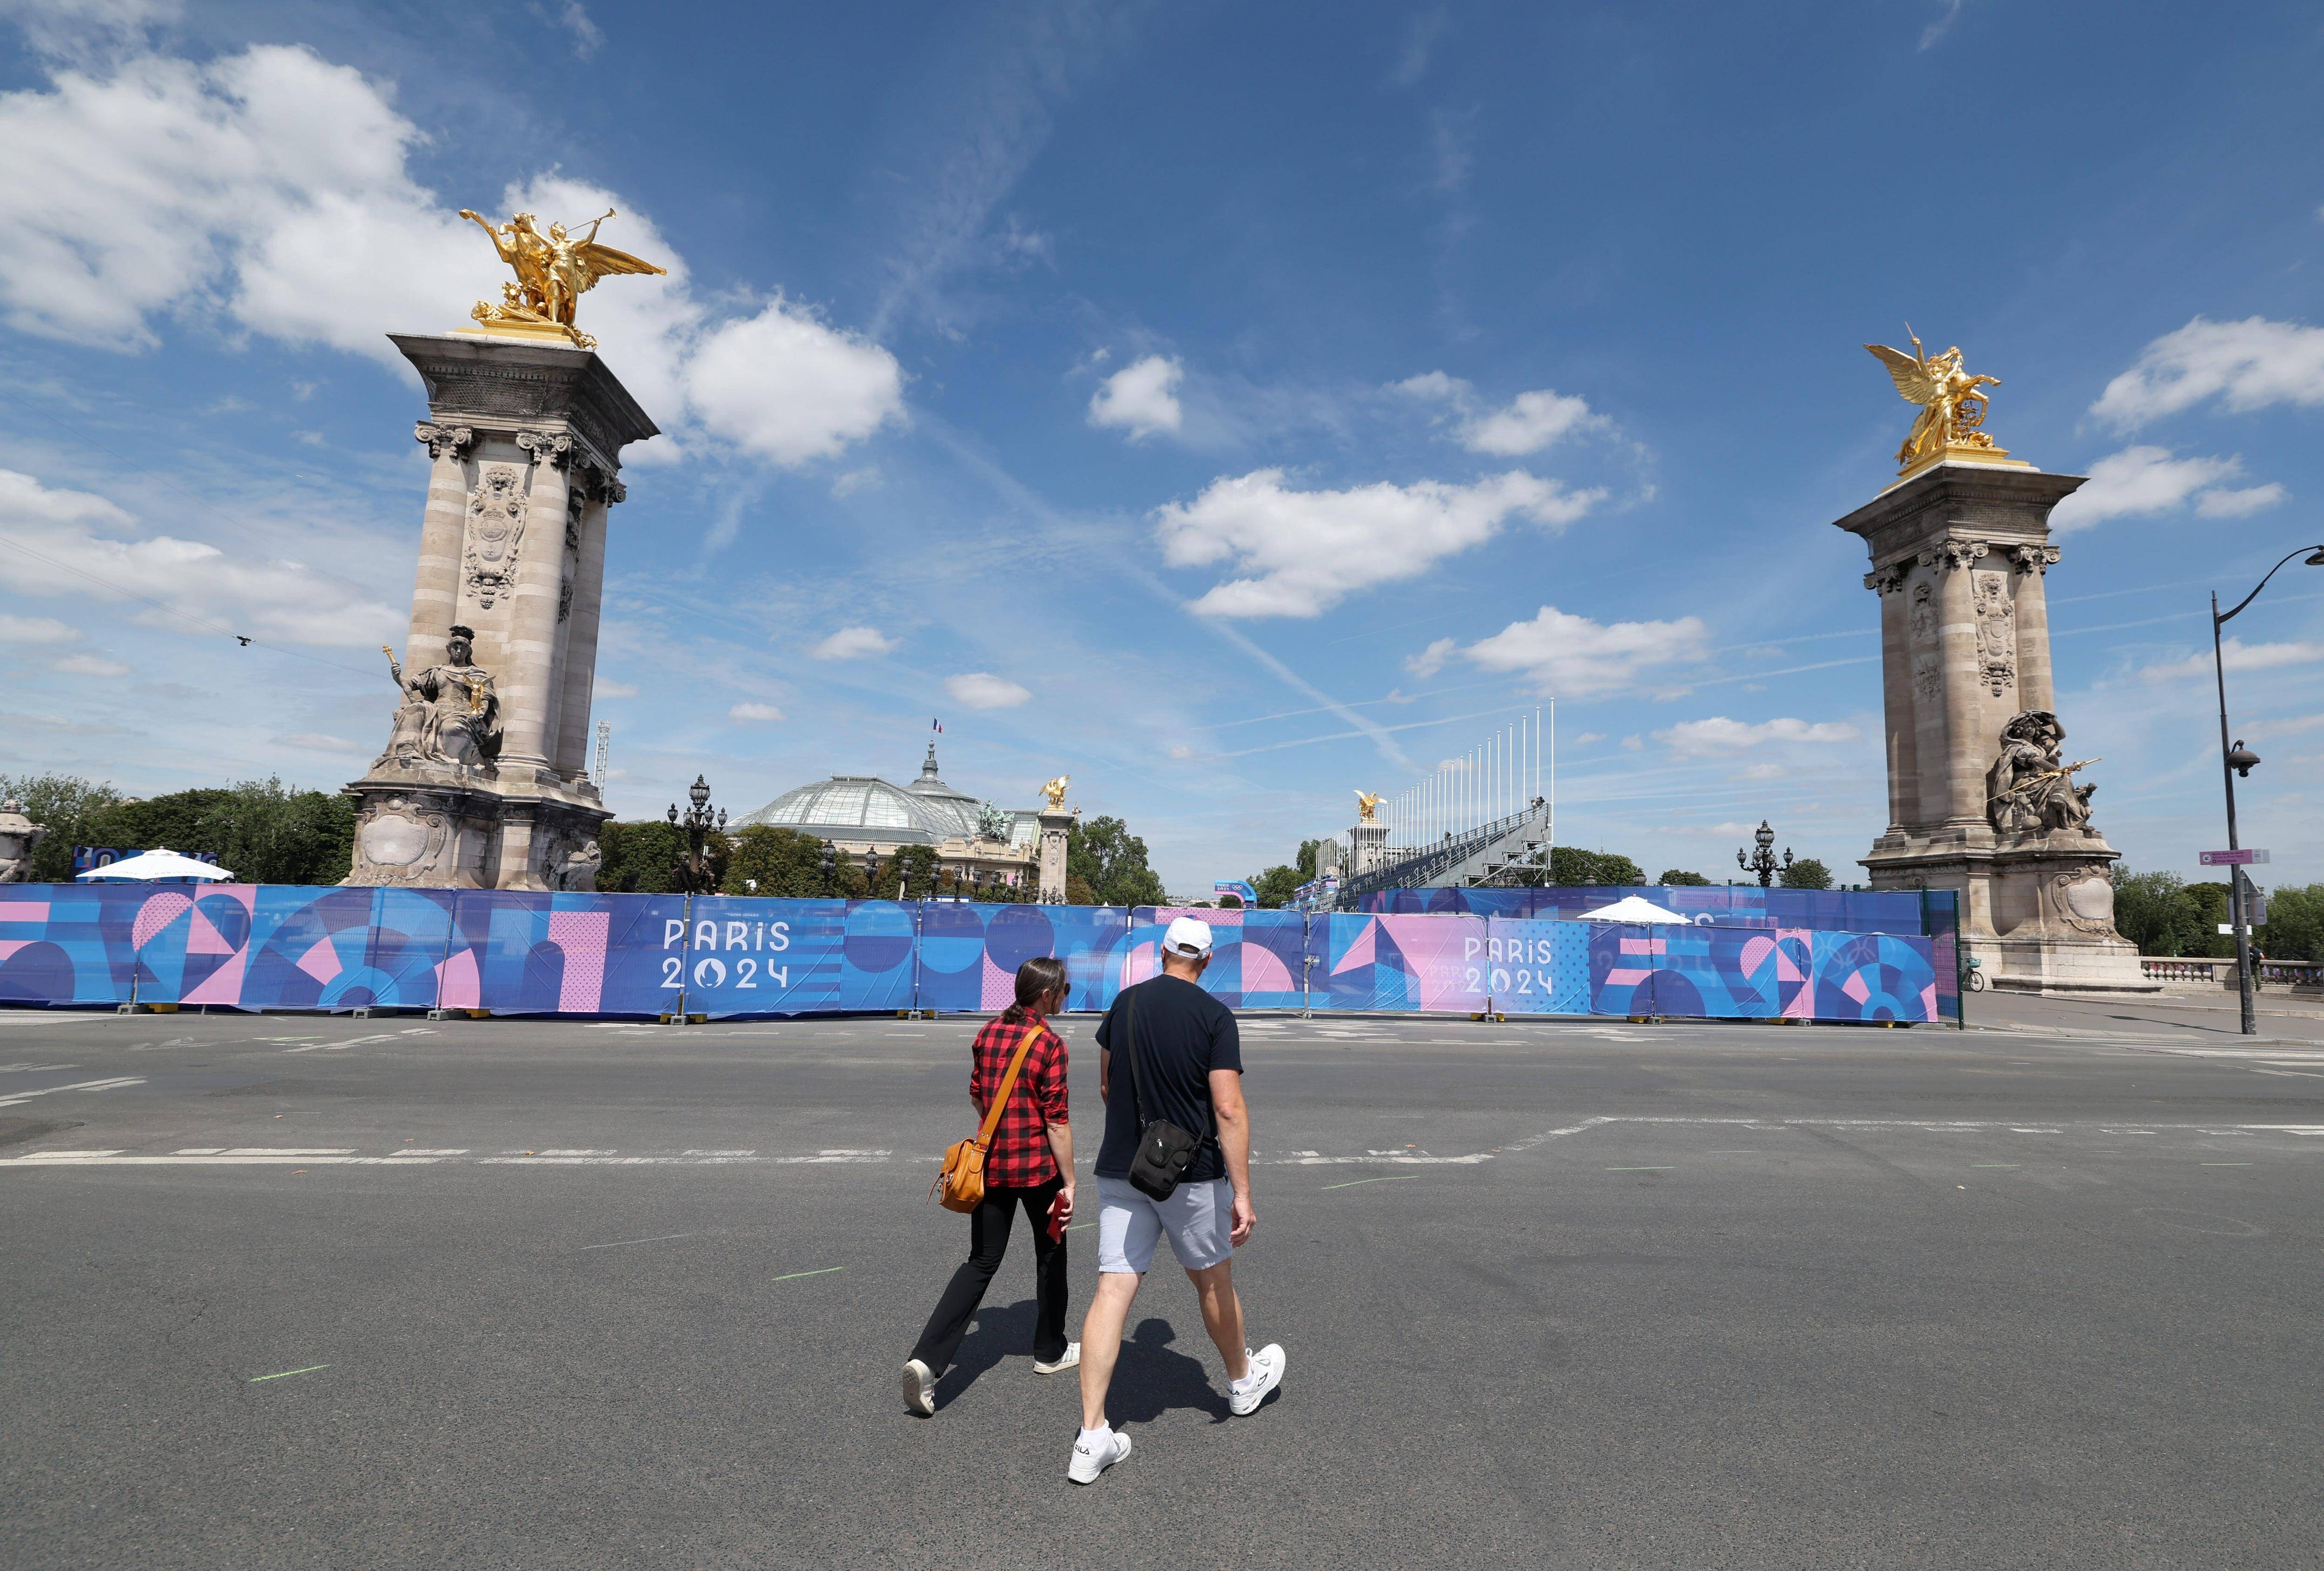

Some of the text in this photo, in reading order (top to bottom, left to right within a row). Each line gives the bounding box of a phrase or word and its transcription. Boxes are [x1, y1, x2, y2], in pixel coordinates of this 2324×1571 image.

[660, 957, 787, 988] 2024
[1465, 968, 1552, 994] 2024
[1075, 1444, 1089, 1455] FILA
